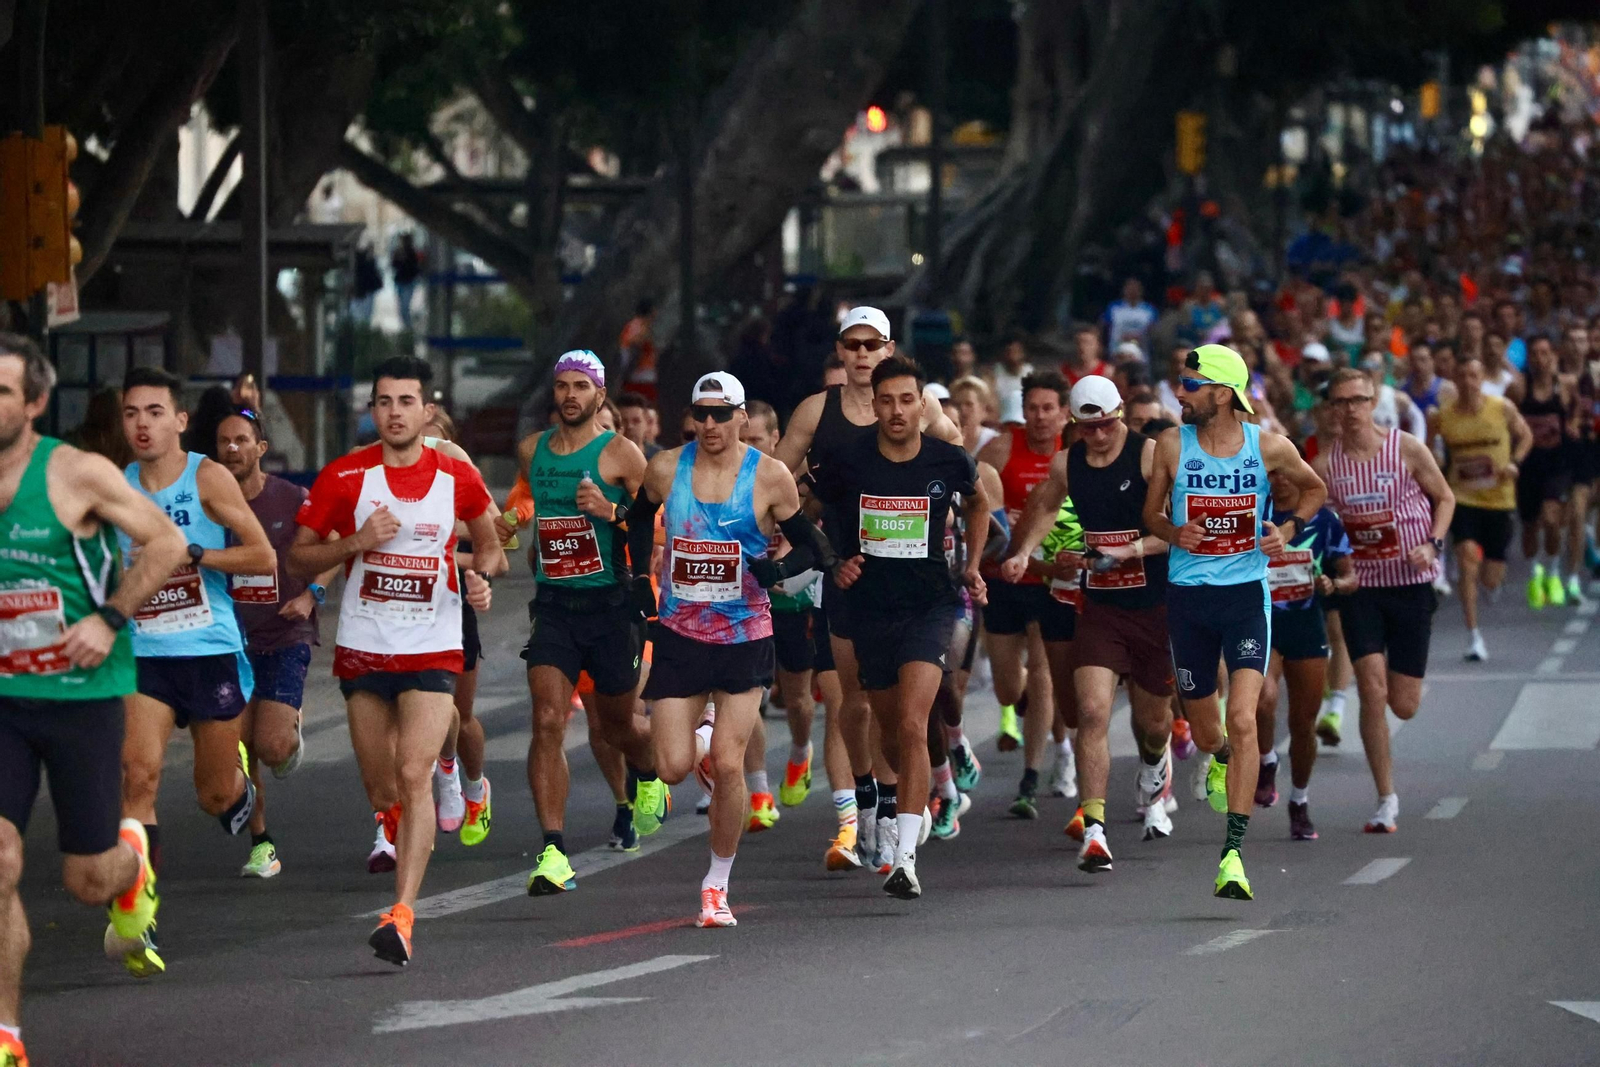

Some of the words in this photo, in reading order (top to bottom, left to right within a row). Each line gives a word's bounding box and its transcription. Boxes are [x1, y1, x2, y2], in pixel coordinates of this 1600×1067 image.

[1186, 468, 1258, 495] nerja
[878, 500, 925, 510] GENERALI
[1205, 497, 1252, 508] GENERALI
[546, 520, 587, 531] GENERALI
[874, 519, 915, 531] 18057
[1205, 517, 1238, 529] 6251
[1094, 534, 1135, 544] GENERALI
[549, 539, 579, 552] 3643
[688, 543, 735, 554] GENERALI
[383, 554, 435, 570] GENERALI
[685, 562, 726, 575] 17212
[376, 576, 421, 594] 12021
